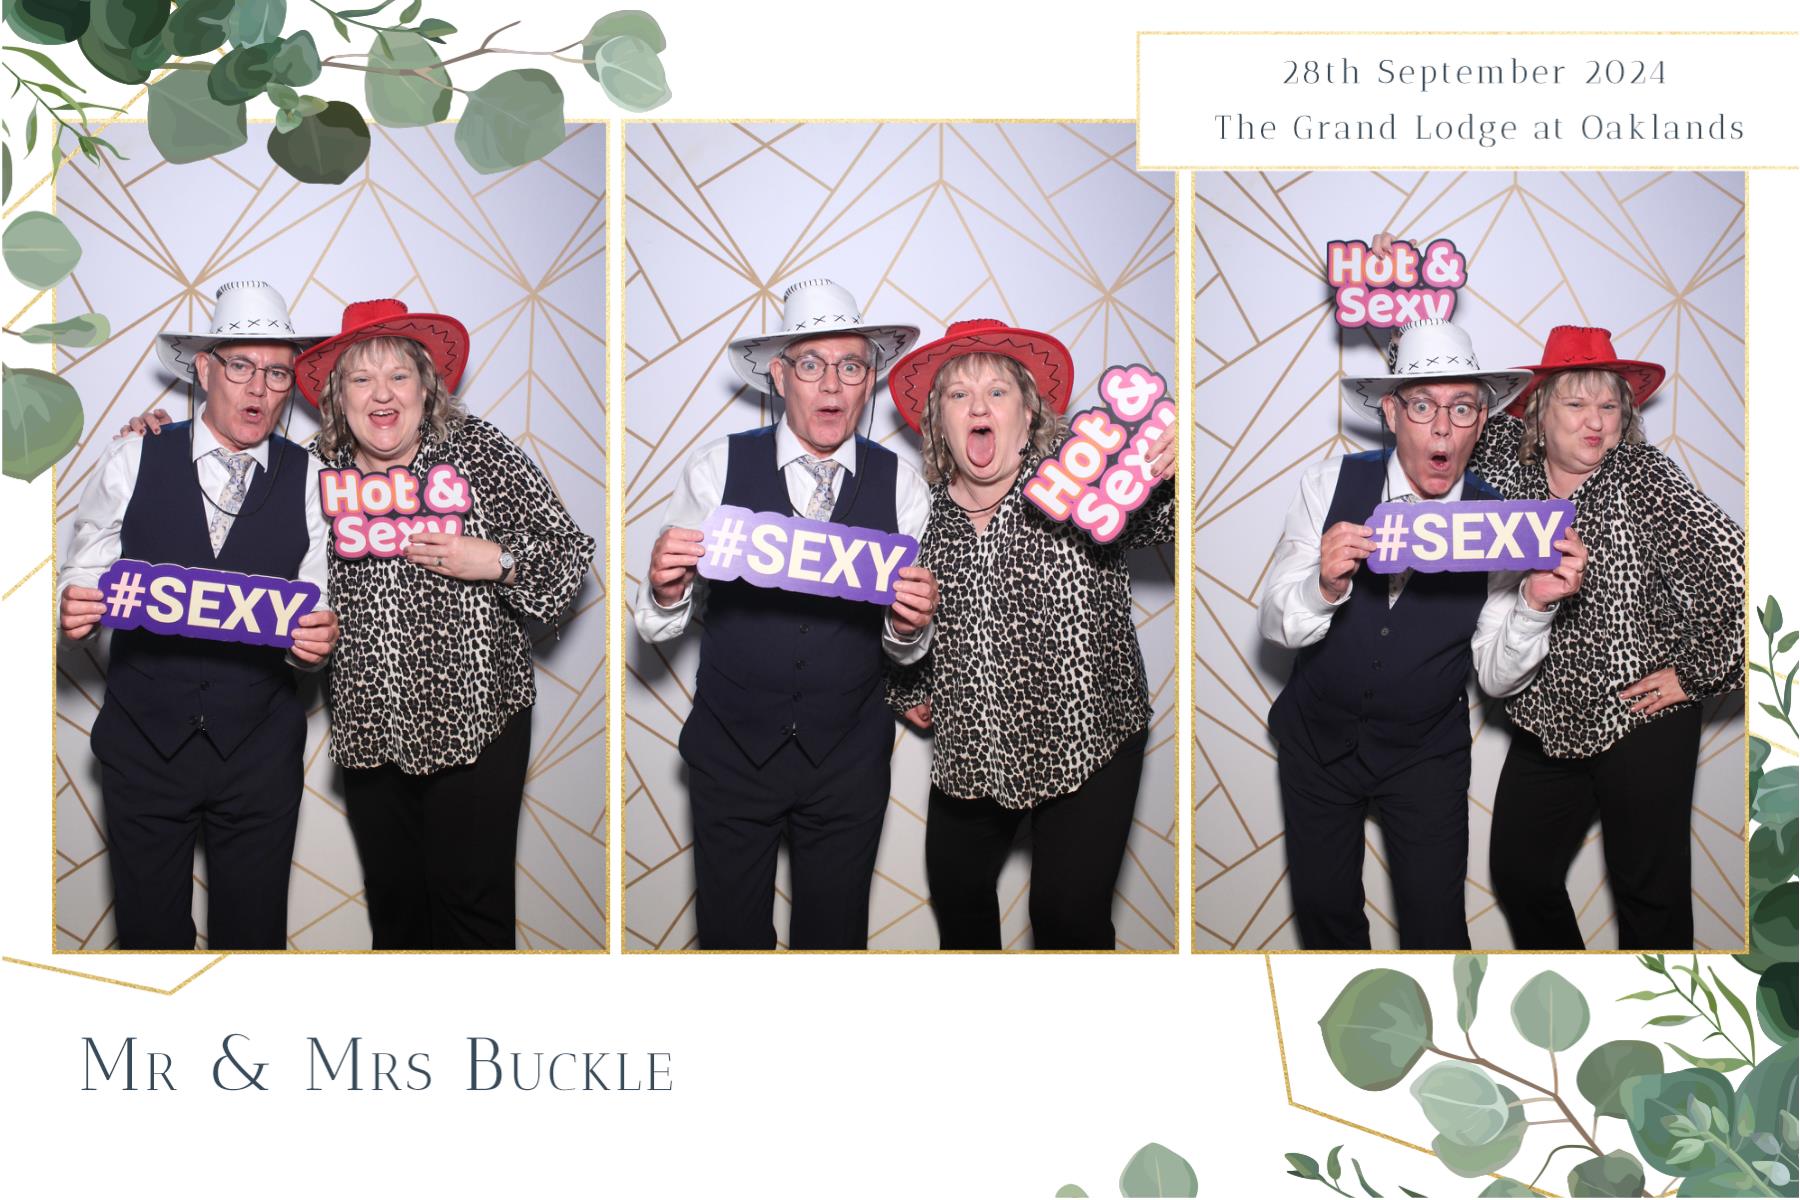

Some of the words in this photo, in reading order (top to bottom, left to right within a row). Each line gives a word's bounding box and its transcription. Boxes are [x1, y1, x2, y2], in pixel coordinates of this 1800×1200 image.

[1332, 247, 1414, 283] Hot
[1426, 246, 1461, 283] &
[1029, 416, 1121, 516] Hot
[1106, 373, 1158, 416] &
[325, 472, 415, 512] Hot
[428, 470, 466, 509] &
[706, 517, 908, 593] #SEXY
[1374, 510, 1565, 562] #SEXY
[105, 570, 309, 637] #SEXY
